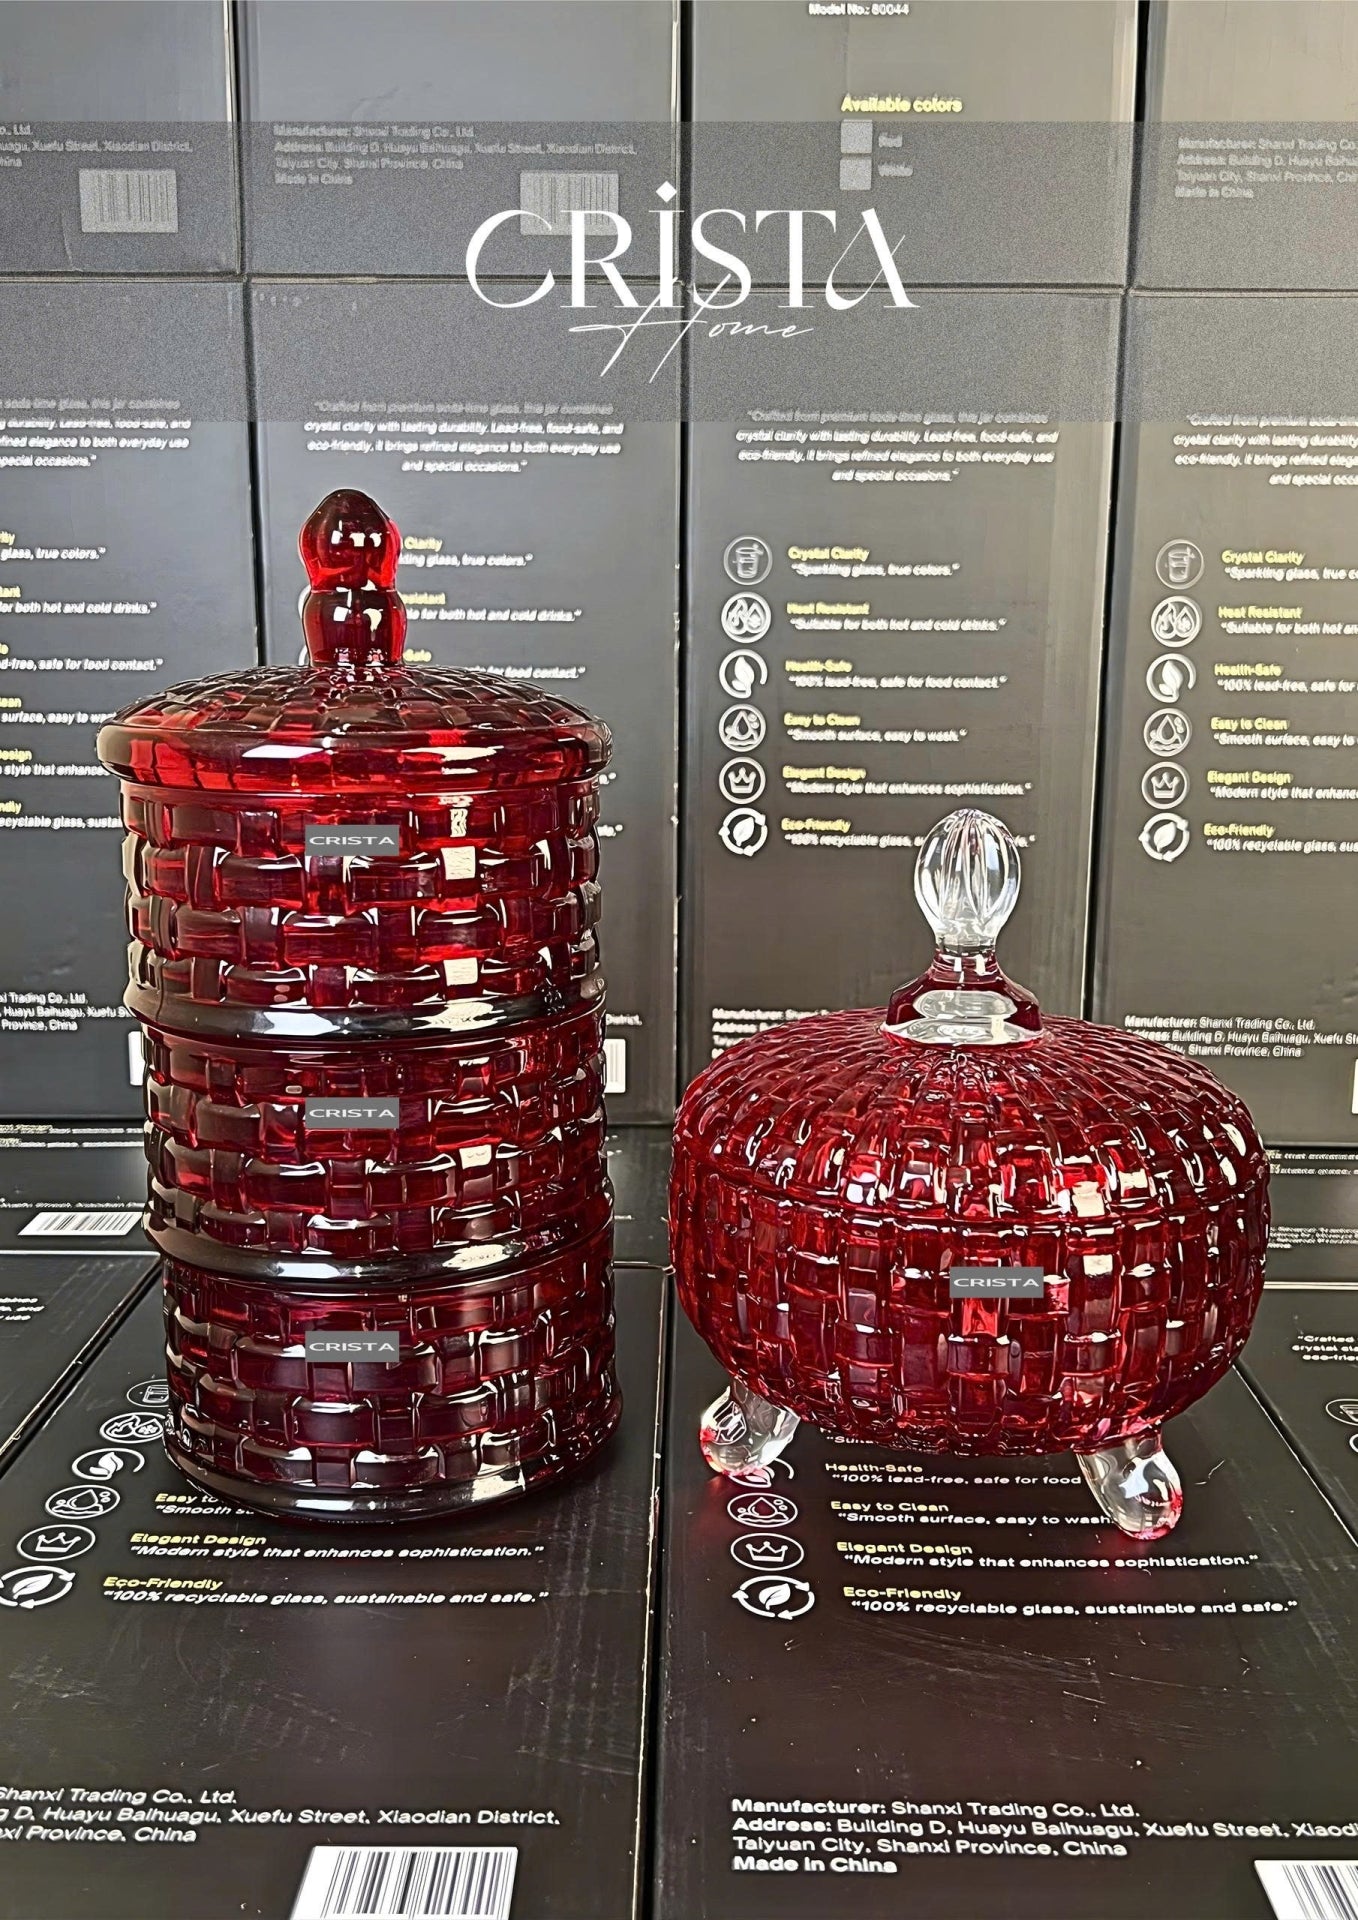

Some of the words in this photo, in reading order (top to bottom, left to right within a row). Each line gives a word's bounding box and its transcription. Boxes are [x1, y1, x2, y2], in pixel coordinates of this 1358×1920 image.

[825, 1463, 922, 1476] Health-Safe
[974, 1476, 1009, 1484] safe
[1014, 1475, 1038, 1484] for
[1043, 1476, 1081, 1484] food
[155, 1493, 197, 1506] Easy
[830, 1500, 871, 1512] Easy
[875, 1502, 894, 1511] to
[898, 1502, 948, 1511] Clean
[995, 1516, 1036, 1525] easy
[1042, 1515, 1060, 1524] to
[130, 1532, 199, 1548] Elegant
[203, 1534, 266, 1549] Design
[836, 1541, 905, 1555] Elegant
[909, 1543, 972, 1555] Design
[212, 1544, 259, 1558] style
[263, 1547, 300, 1557] that
[304, 1548, 393, 1557] enhances
[929, 1553, 973, 1568] style
[978, 1557, 1014, 1567] that
[1019, 1557, 1109, 1567] enhances
[103, 1576, 222, 1590] Eco-Friendly
[164, 1589, 267, 1604] recyclable
[334, 1593, 445, 1603] sustainable
[449, 1592, 487, 1603] and
[843, 1586, 960, 1601] Eco-Friendly
[915, 1599, 1016, 1615] recyclable
[1085, 1603, 1195, 1614] sustainable
[1201, 1602, 1236, 1613] and
[71, 1787, 146, 1804] Trading
[42, 1806, 111, 1823] Huayu
[228, 1808, 292, 1823] Xuefu
[377, 1809, 470, 1824] Xiaodian
[732, 1798, 885, 1814] Manufacturer:
[891, 1800, 962, 1815] Shanxi
[967, 1802, 1047, 1819] Trading
[134, 1826, 196, 1842] China
[733, 1817, 831, 1832] Address:
[837, 1818, 923, 1835] Building
[958, 1820, 1026, 1836] Huayu
[1143, 1822, 1208, 1836] Xuefu
[1291, 1822, 1358, 1836] Xiaod
[733, 1836, 815, 1853] Taiyuan
[877, 1838, 950, 1853] Shanxi
[1063, 1840, 1127, 1856] China
[733, 1855, 798, 1871] Made
[804, 1856, 825, 1871] in
[830, 1857, 897, 1873] China
